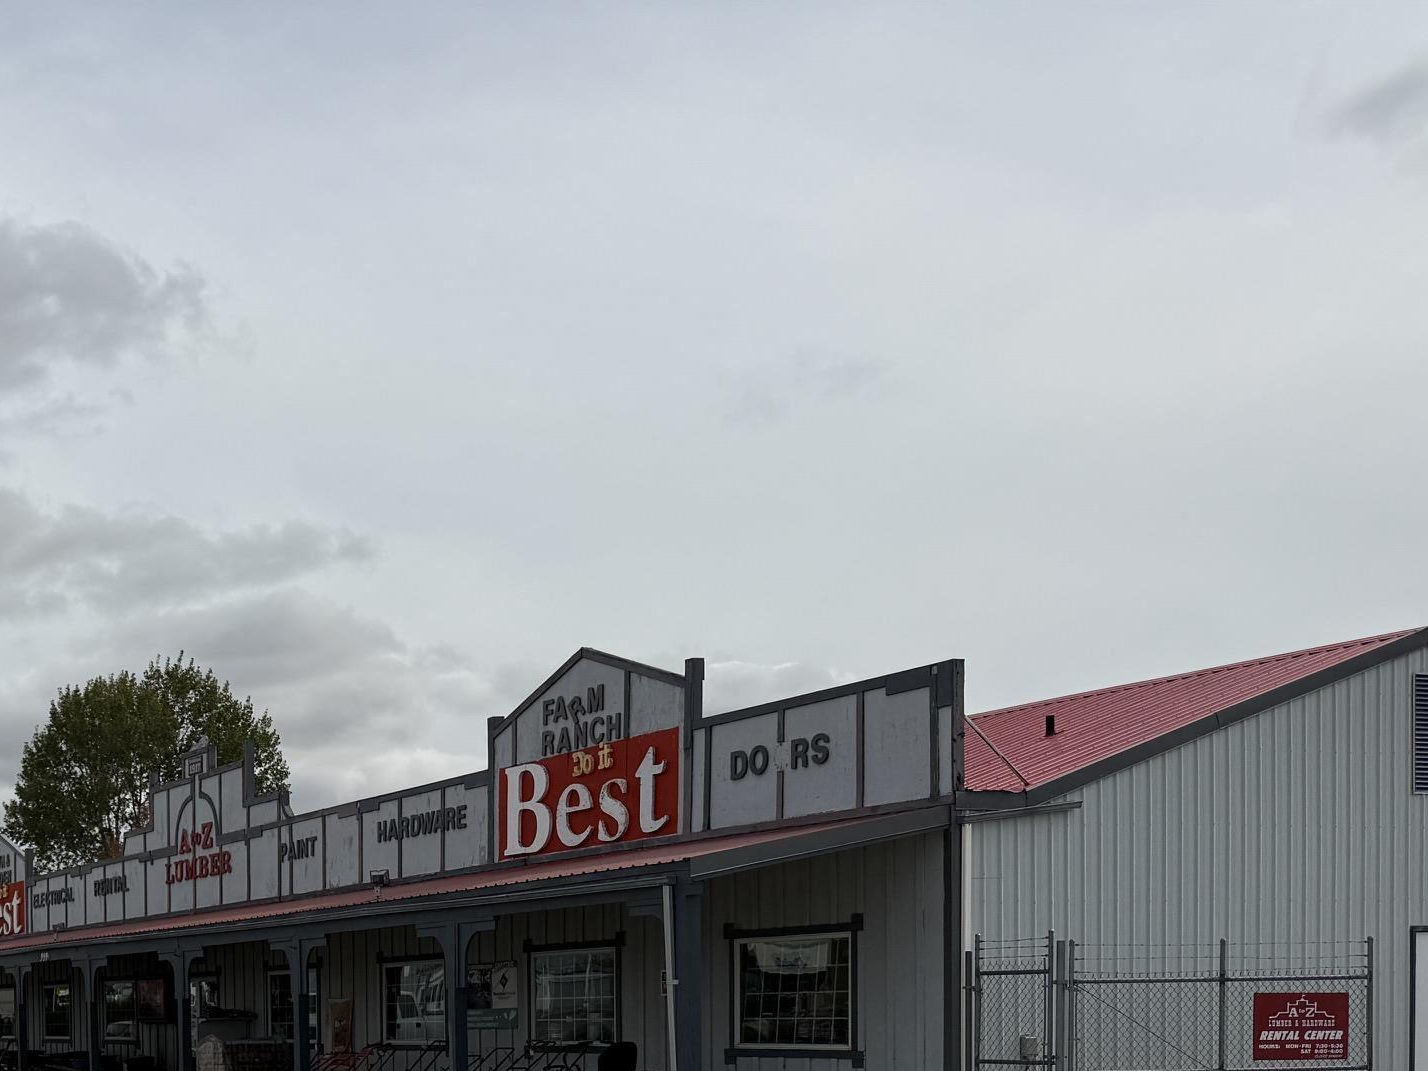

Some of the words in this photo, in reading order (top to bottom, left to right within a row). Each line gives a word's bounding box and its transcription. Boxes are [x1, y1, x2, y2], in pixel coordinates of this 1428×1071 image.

[542, 684, 604, 726] FARM
[541, 712, 621, 756] RANCH
[572, 751, 594, 777] Do
[598, 742, 614, 770] it
[504, 746, 670, 857] Best
[178, 828, 192, 855] A
[201, 821, 214, 850] Z
[376, 804, 468, 843] HARDWARE
[280, 836, 318, 863] PAINT
[165, 850, 232, 885] LUMBER
[33, 887, 75, 909] ELECTRICAL
[93, 874, 130, 897] RENTAL
[1289, 1007, 1299, 1018] A
[1305, 1007, 1315, 1018] Z
[1259, 1030, 1300, 1041] RENTAL
[1304, 1030, 1344, 1040] CENTER
